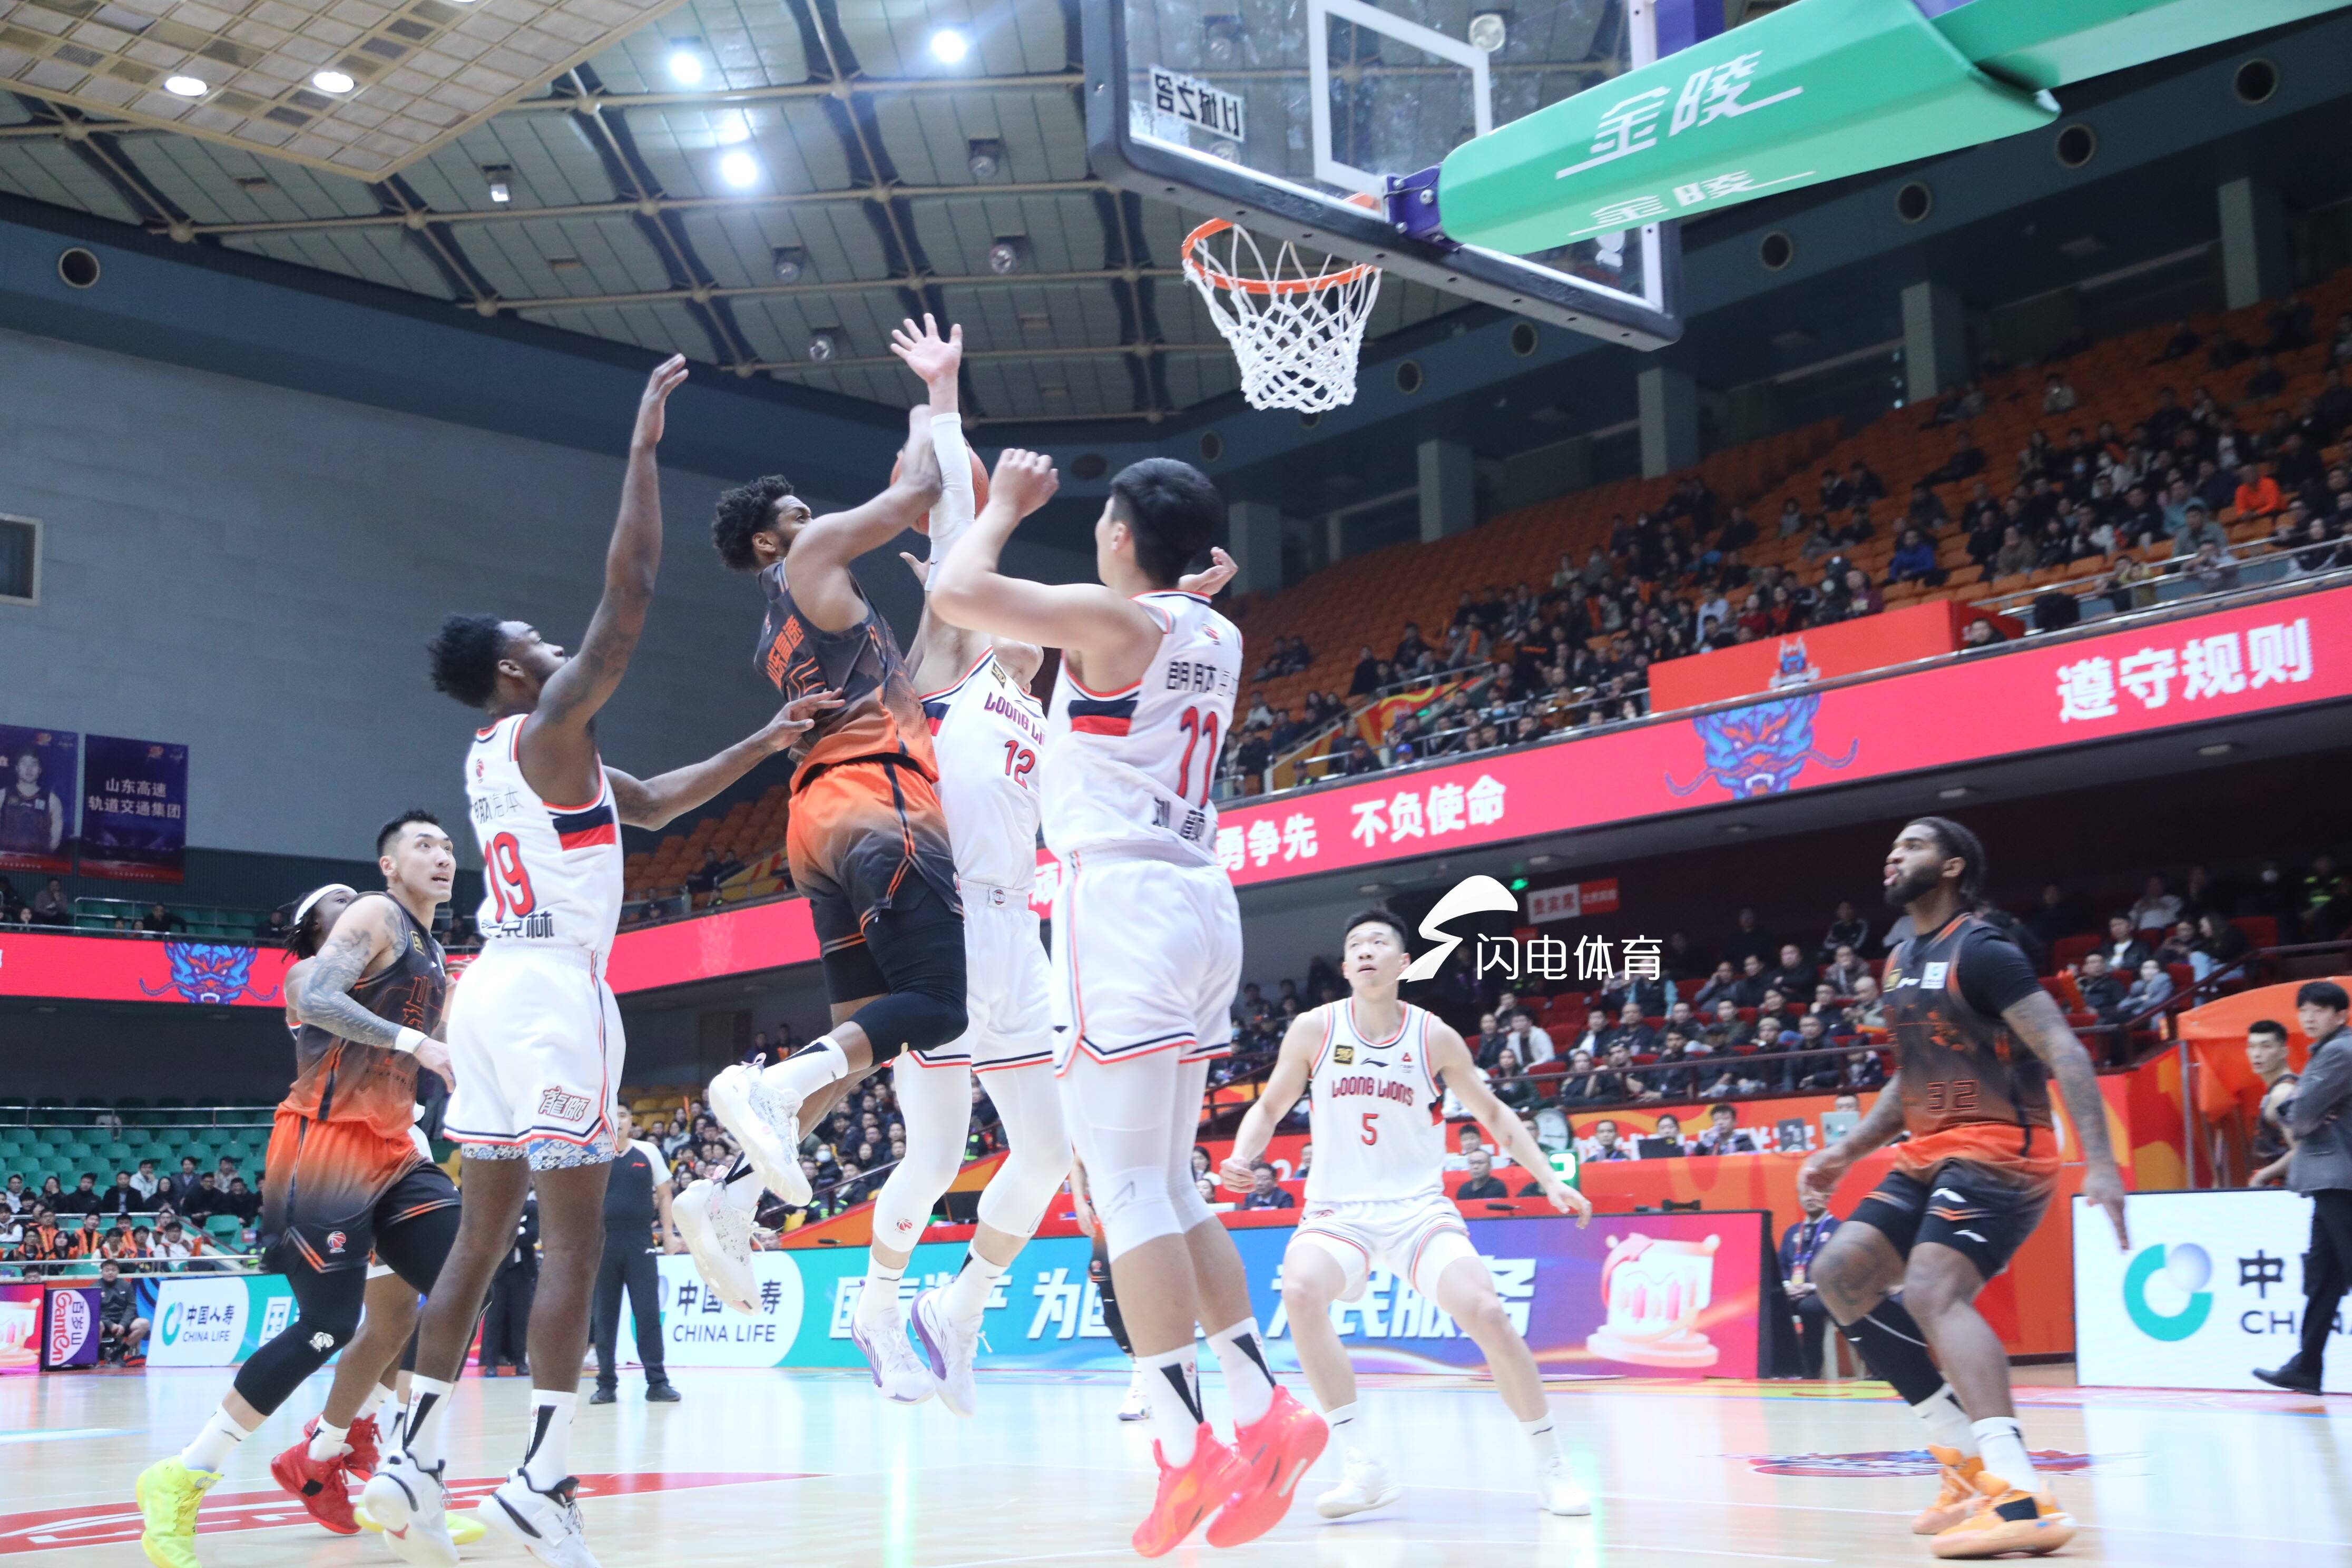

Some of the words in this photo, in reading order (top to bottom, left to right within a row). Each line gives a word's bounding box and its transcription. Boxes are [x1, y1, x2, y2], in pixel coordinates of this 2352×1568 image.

[1555, 50, 1804, 180] 金陵
[2056, 618, 2314, 723] 遵守规则
[1004, 740, 1035, 790] 12
[1180, 705, 1217, 809] 11
[88, 795, 181, 819] 轨道交通集团
[105, 777, 166, 798] 山东高速
[1351, 774, 1506, 848] 不负使命
[484, 831, 537, 924] 19
[1361, 1112, 1379, 1146] 5
[186, 1304, 235, 1327] 中国人寿
[678, 1279, 782, 1316] 中国寿
[71, 1301, 84, 1345] 百岁山
[183, 1331, 209, 1342] CHINA
[212, 1330, 231, 1341] LIFE
[673, 1324, 729, 1342] CHINA
[736, 1324, 777, 1342] LIFE
